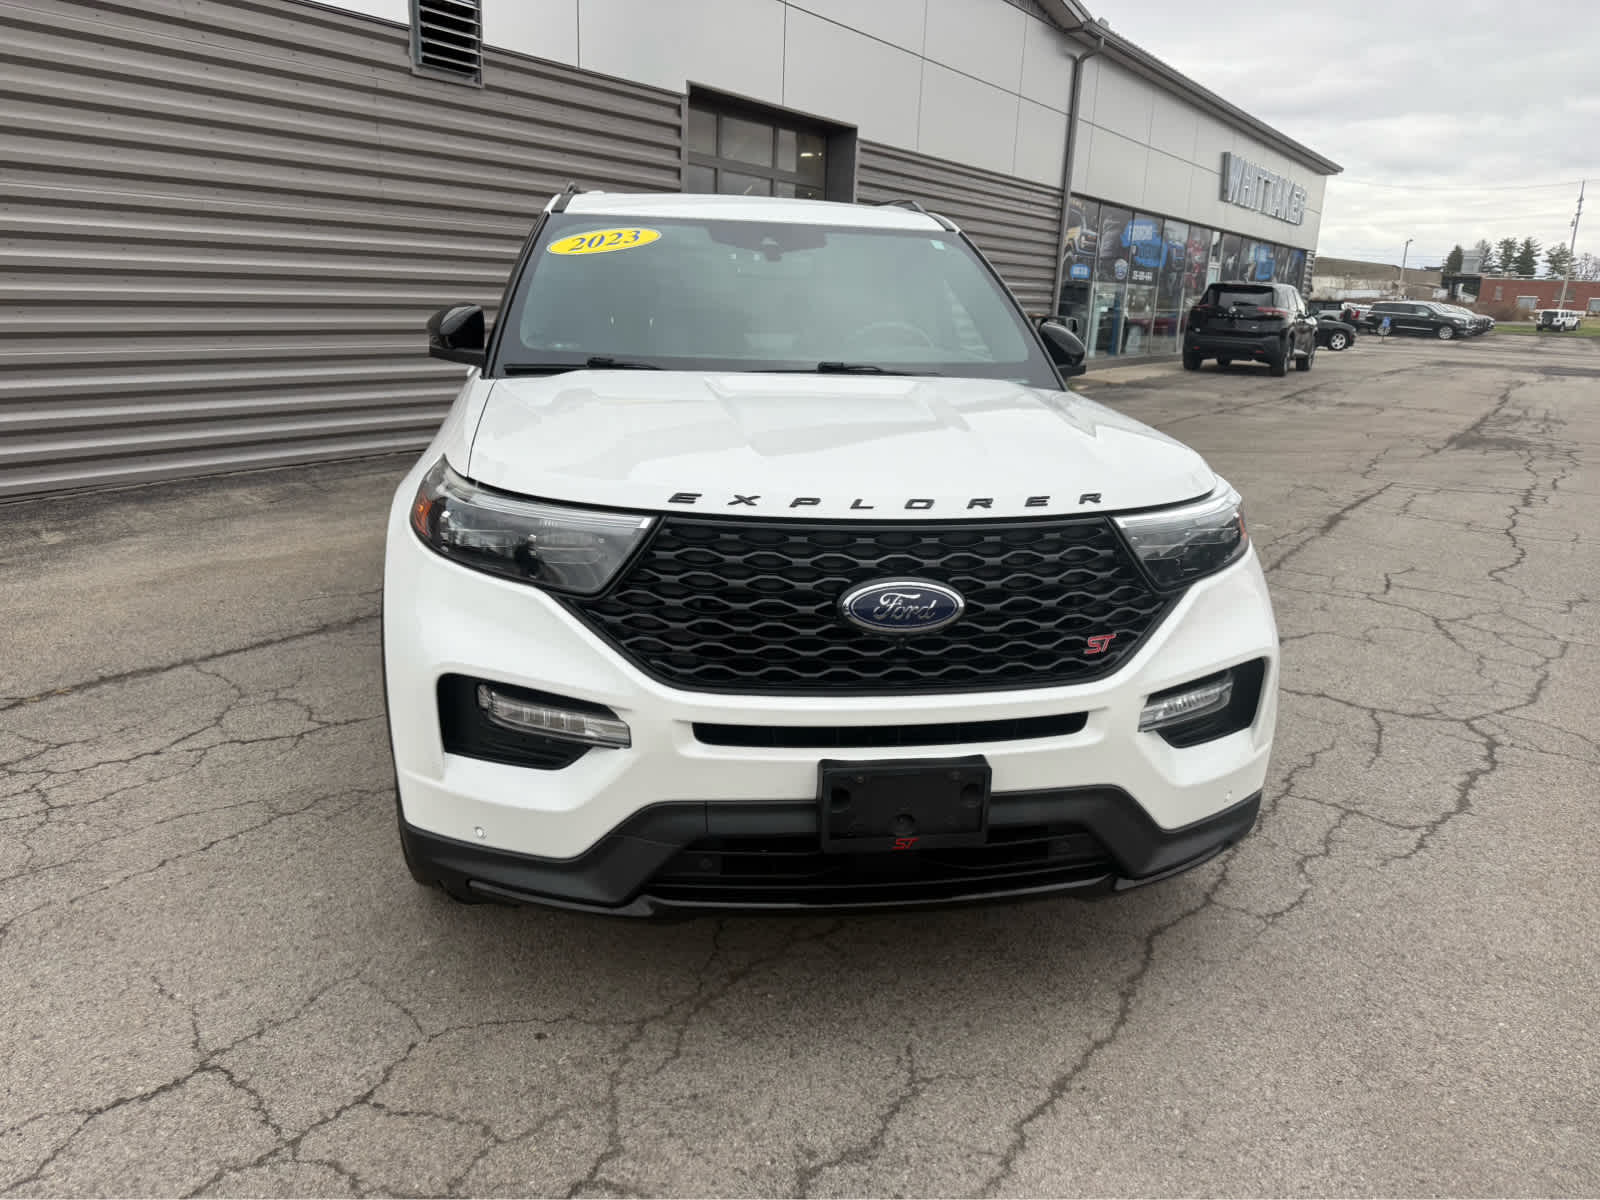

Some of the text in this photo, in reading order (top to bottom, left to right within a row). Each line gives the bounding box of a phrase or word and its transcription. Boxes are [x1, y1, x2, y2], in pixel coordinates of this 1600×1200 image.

[1224, 152, 1306, 225] WHITTAKER
[570, 229, 640, 252] 2023
[668, 492, 1104, 510] EXPLORER
[872, 592, 938, 622] Ford
[1085, 633, 1117, 654] ST
[892, 838, 919, 851] ST
